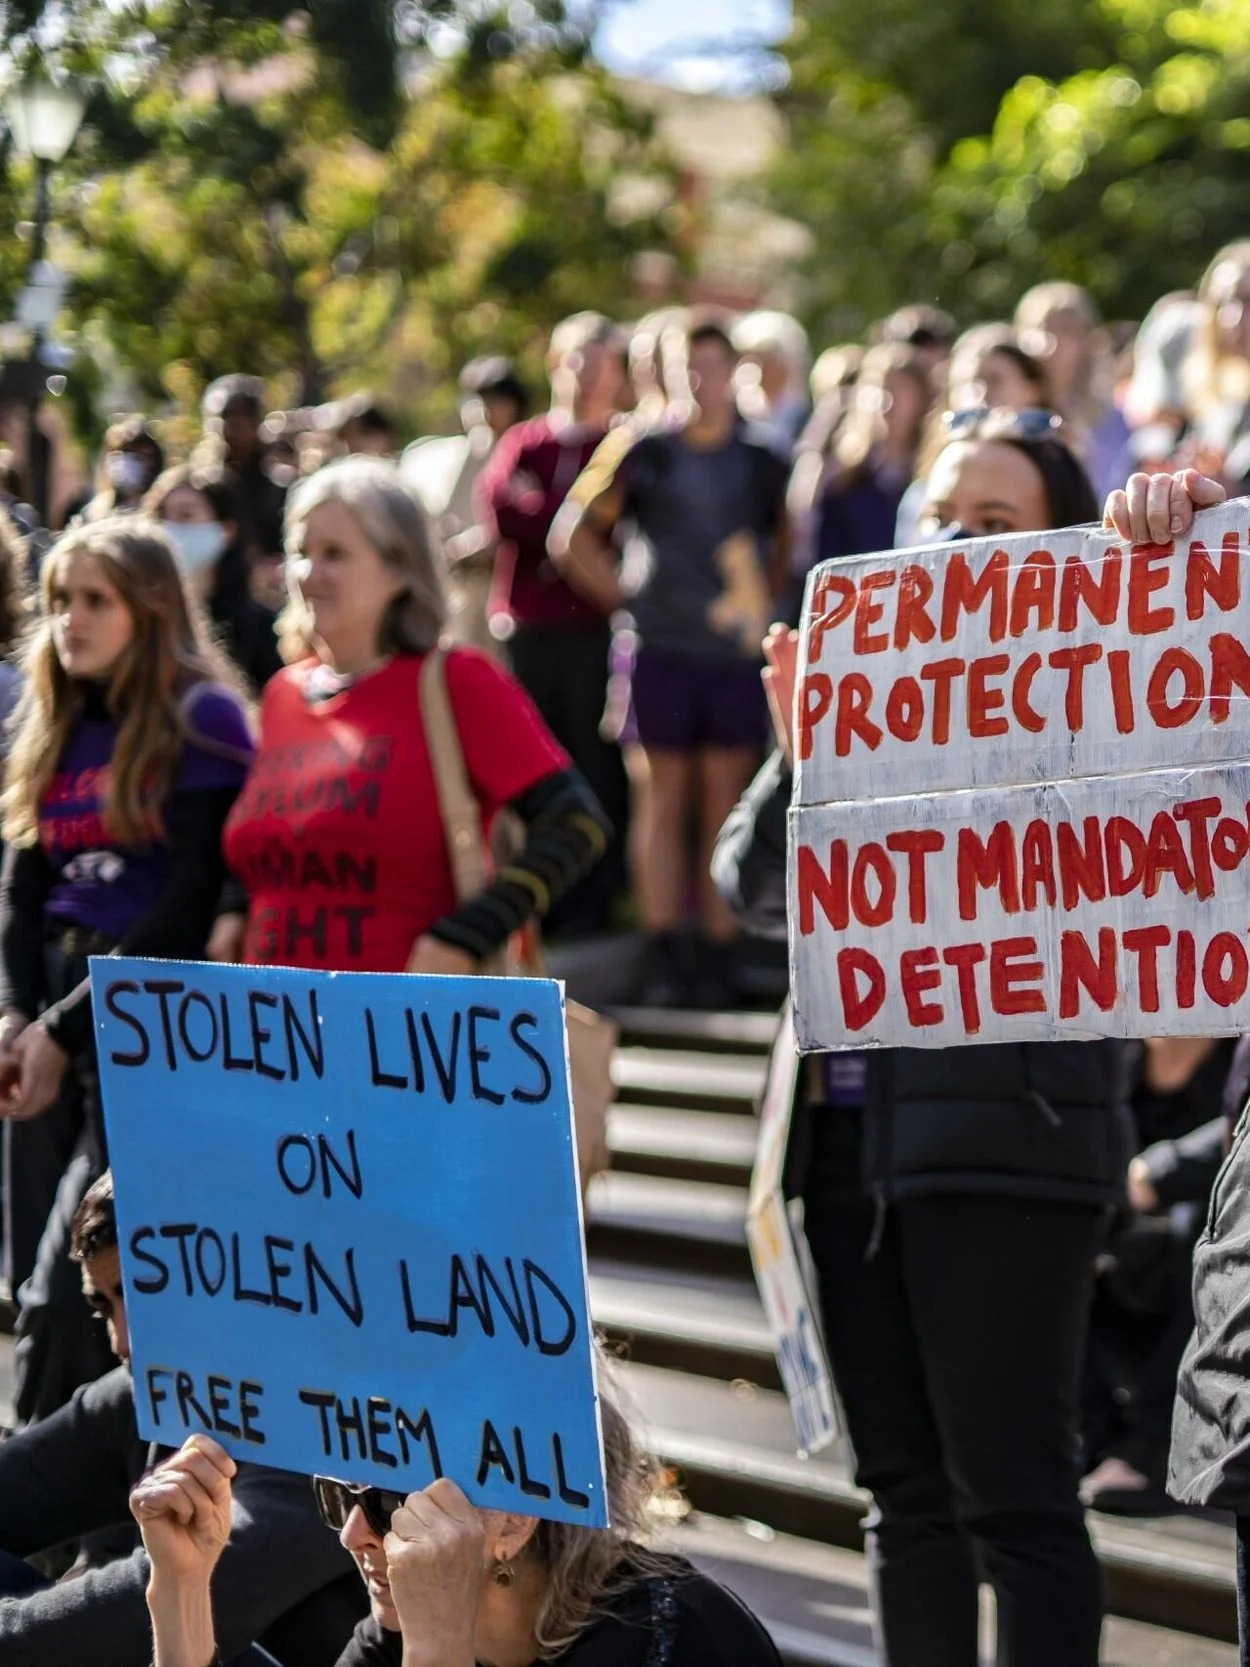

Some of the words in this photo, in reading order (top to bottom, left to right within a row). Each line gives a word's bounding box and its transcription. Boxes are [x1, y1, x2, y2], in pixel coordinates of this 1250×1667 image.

[797, 828, 945, 935] NOT
[104, 979, 325, 1082] STOLEN
[365, 1005, 552, 1105] LIVES
[276, 1129, 363, 1200] ON
[129, 1223, 365, 1328] STOLEN
[400, 1250, 576, 1356] LAND
[145, 1365, 266, 1445] FREE
[299, 1388, 444, 1479] THEM
[476, 1418, 590, 1510] ALL
